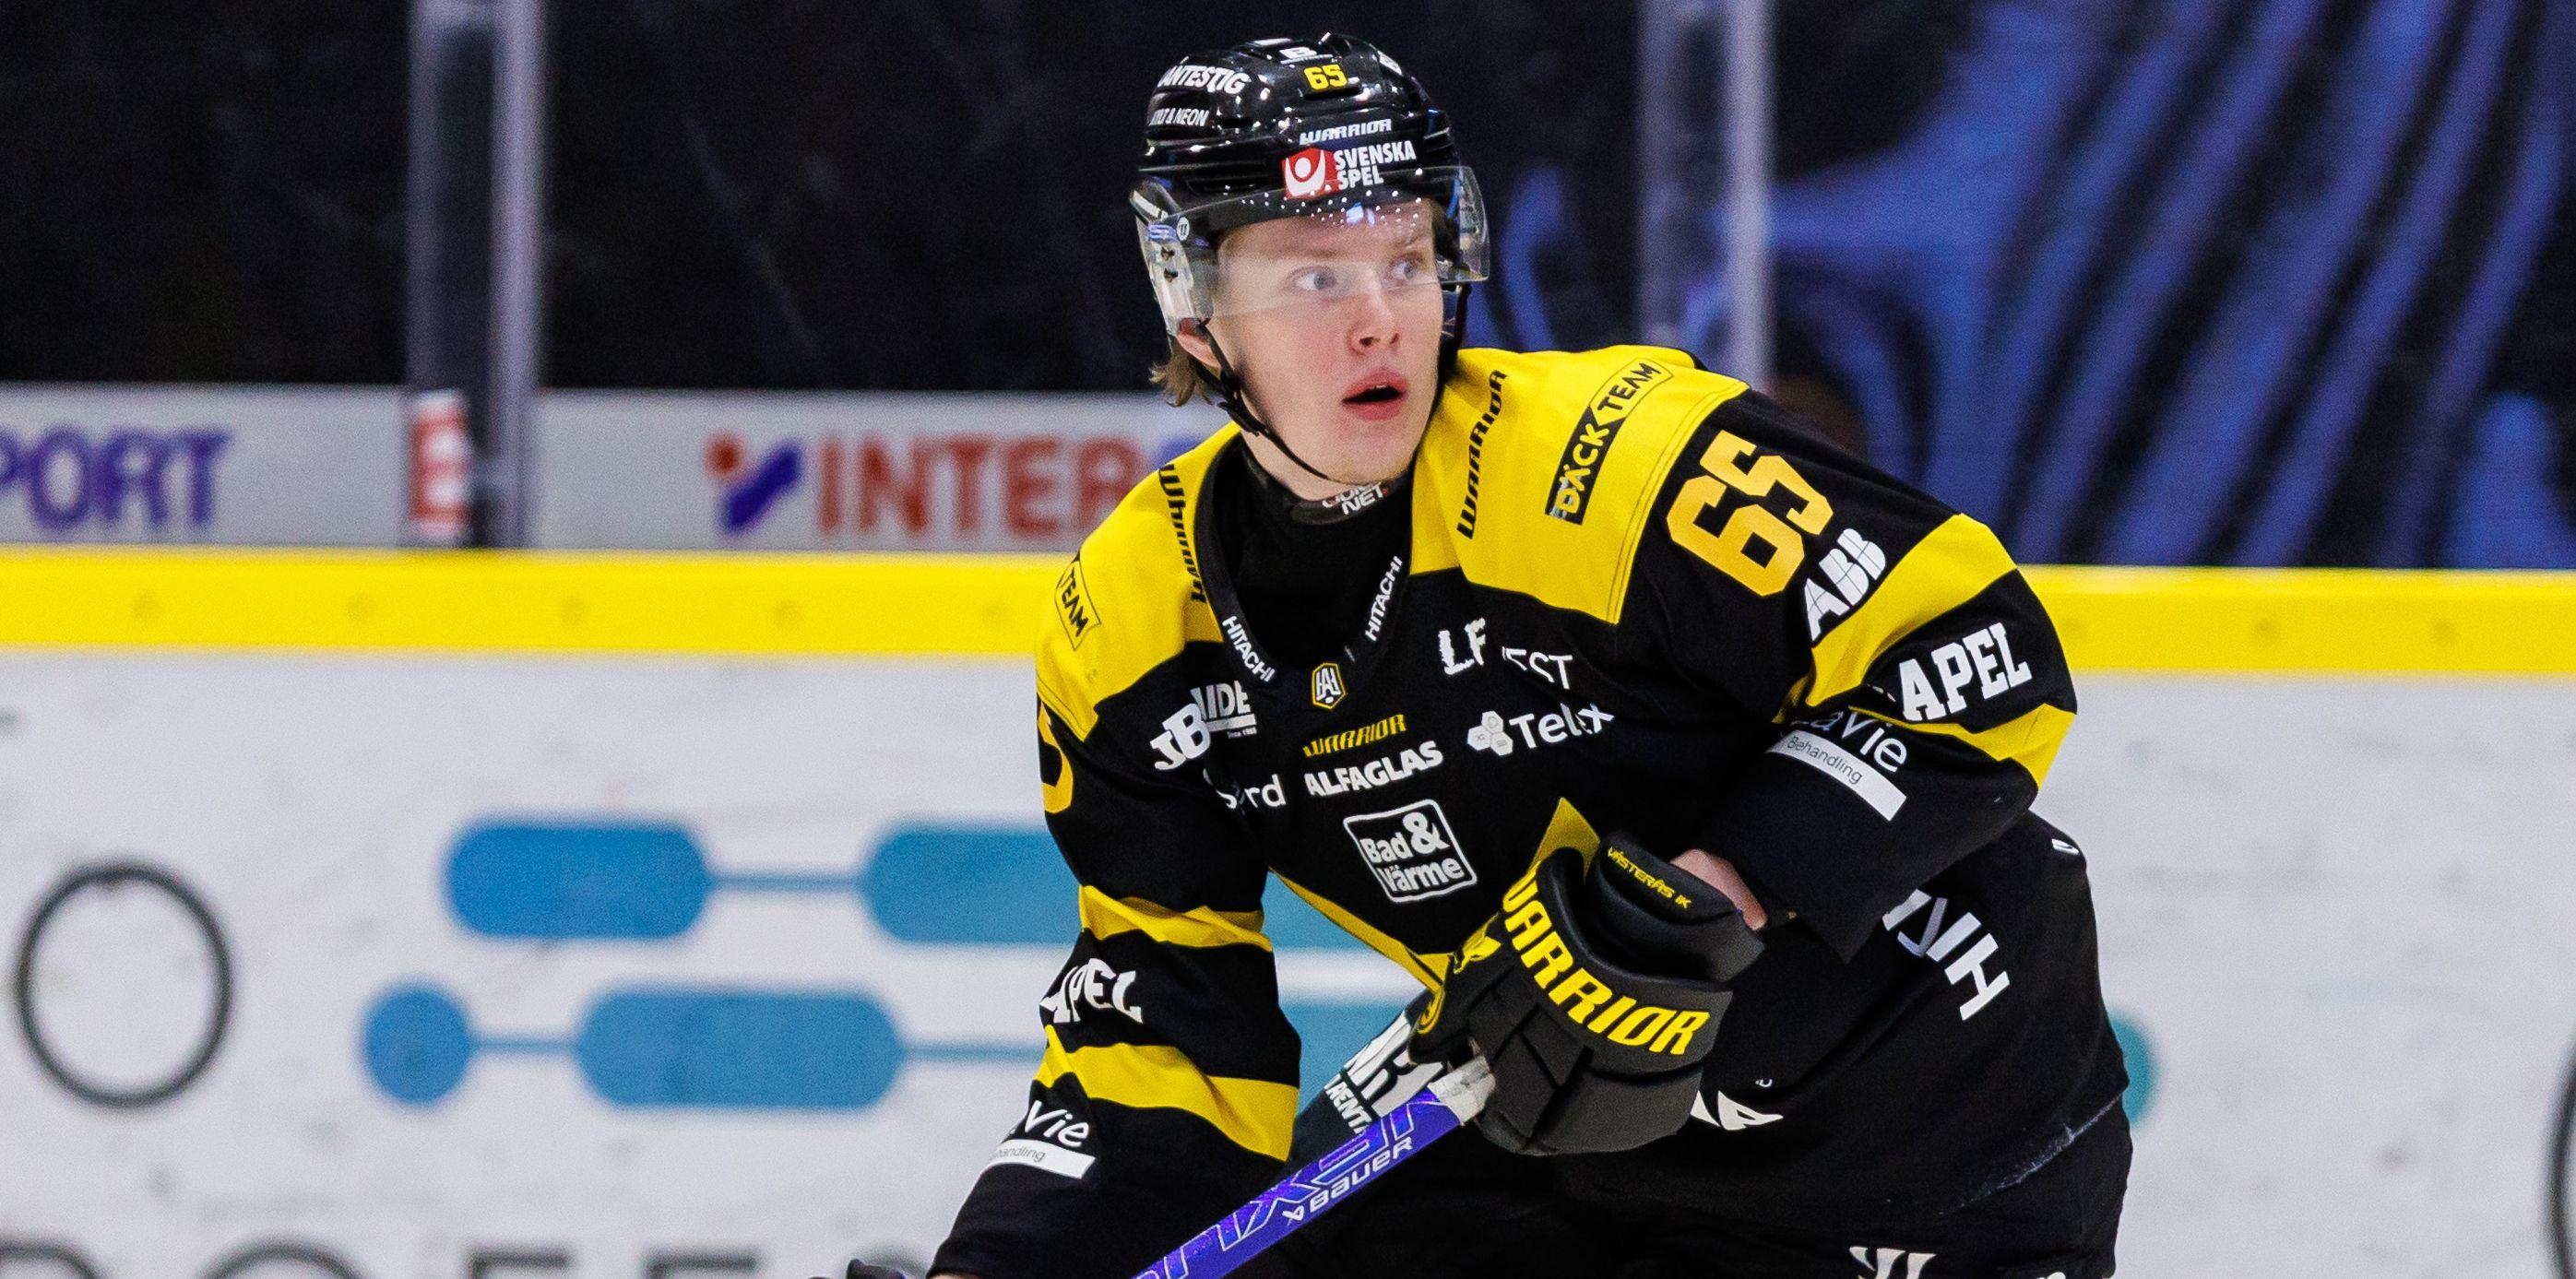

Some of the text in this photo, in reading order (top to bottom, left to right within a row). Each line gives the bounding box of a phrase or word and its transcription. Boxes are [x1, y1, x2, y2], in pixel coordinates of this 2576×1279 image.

[1303, 64, 1347, 90] 65
[1299, 118, 1392, 146] WARRIOR
[1334, 140, 1417, 171] SVENSKA
[1337, 165, 1384, 190] SPEL
[1456, 370, 1507, 539] WARRIOR
[1556, 362, 1661, 516] DÄCK TEAM
[817, 436, 1148, 535] INTER
[1341, 481, 1383, 515] NET
[1666, 429, 1834, 597] 65
[1364, 555, 1403, 642] HITACHI
[1802, 527, 1886, 641] ABB
[1222, 615, 1276, 682] HITACHI
[1898, 622, 2033, 722] APEL
[1149, 703, 1211, 771] JB
[1302, 714, 1407, 757] WARRIOR
[1304, 740, 1444, 797] ALFAGLAS
[1359, 811, 1451, 864] Bad &
[1377, 858, 1465, 893] Värme
